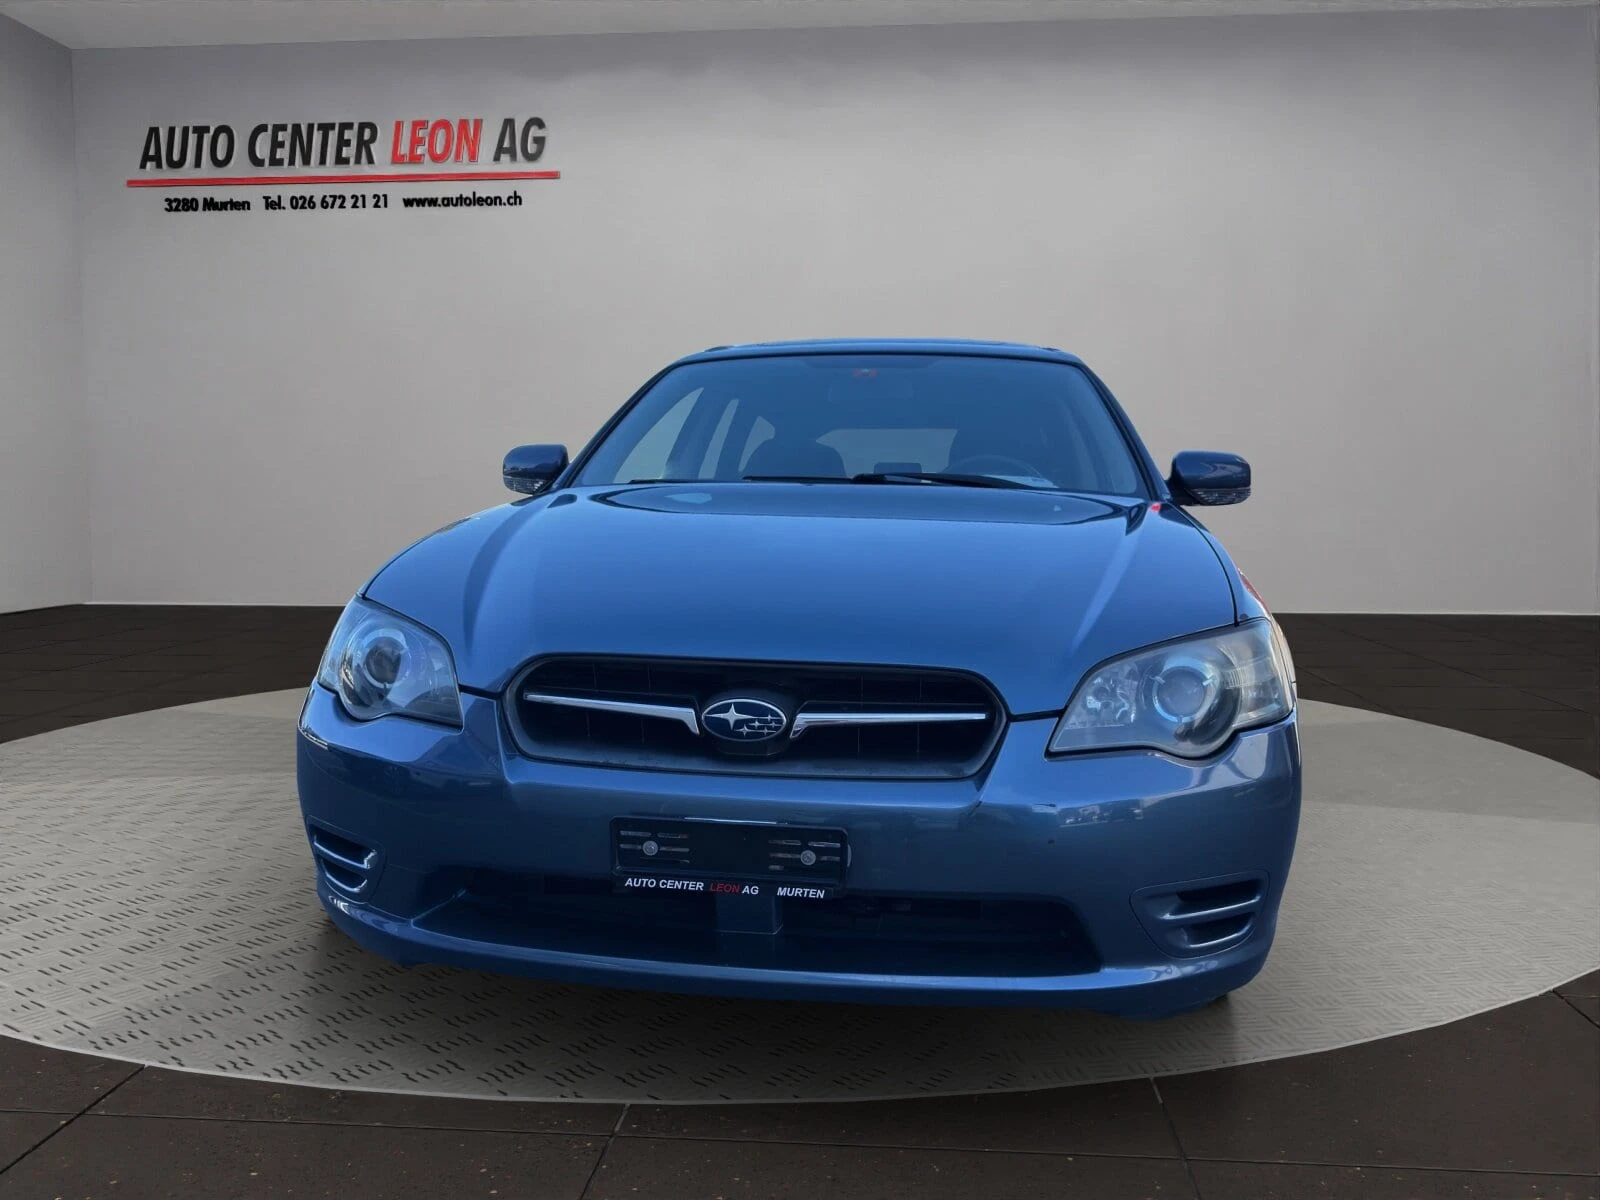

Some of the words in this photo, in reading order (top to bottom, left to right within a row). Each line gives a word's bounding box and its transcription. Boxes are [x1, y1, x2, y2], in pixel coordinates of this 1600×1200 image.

[139, 123, 235, 170] AUTO
[247, 120, 378, 168] CENTER
[391, 118, 482, 164] LEON
[493, 117, 547, 163] AG
[164, 197, 199, 213] 3280
[202, 196, 251, 212] Murten
[263, 195, 286, 211] Tel.
[289, 195, 316, 210] 026
[320, 194, 347, 210] 672
[351, 194, 367, 209] 21
[372, 193, 389, 209] 21
[402, 190, 523, 208] www.autoleon.ch
[625, 878, 657, 889] AUTO
[658, 879, 704, 891] CENTER
[709, 883, 740, 894] LEON
[741, 885, 760, 896] AG
[777, 887, 825, 899] MURTEN
